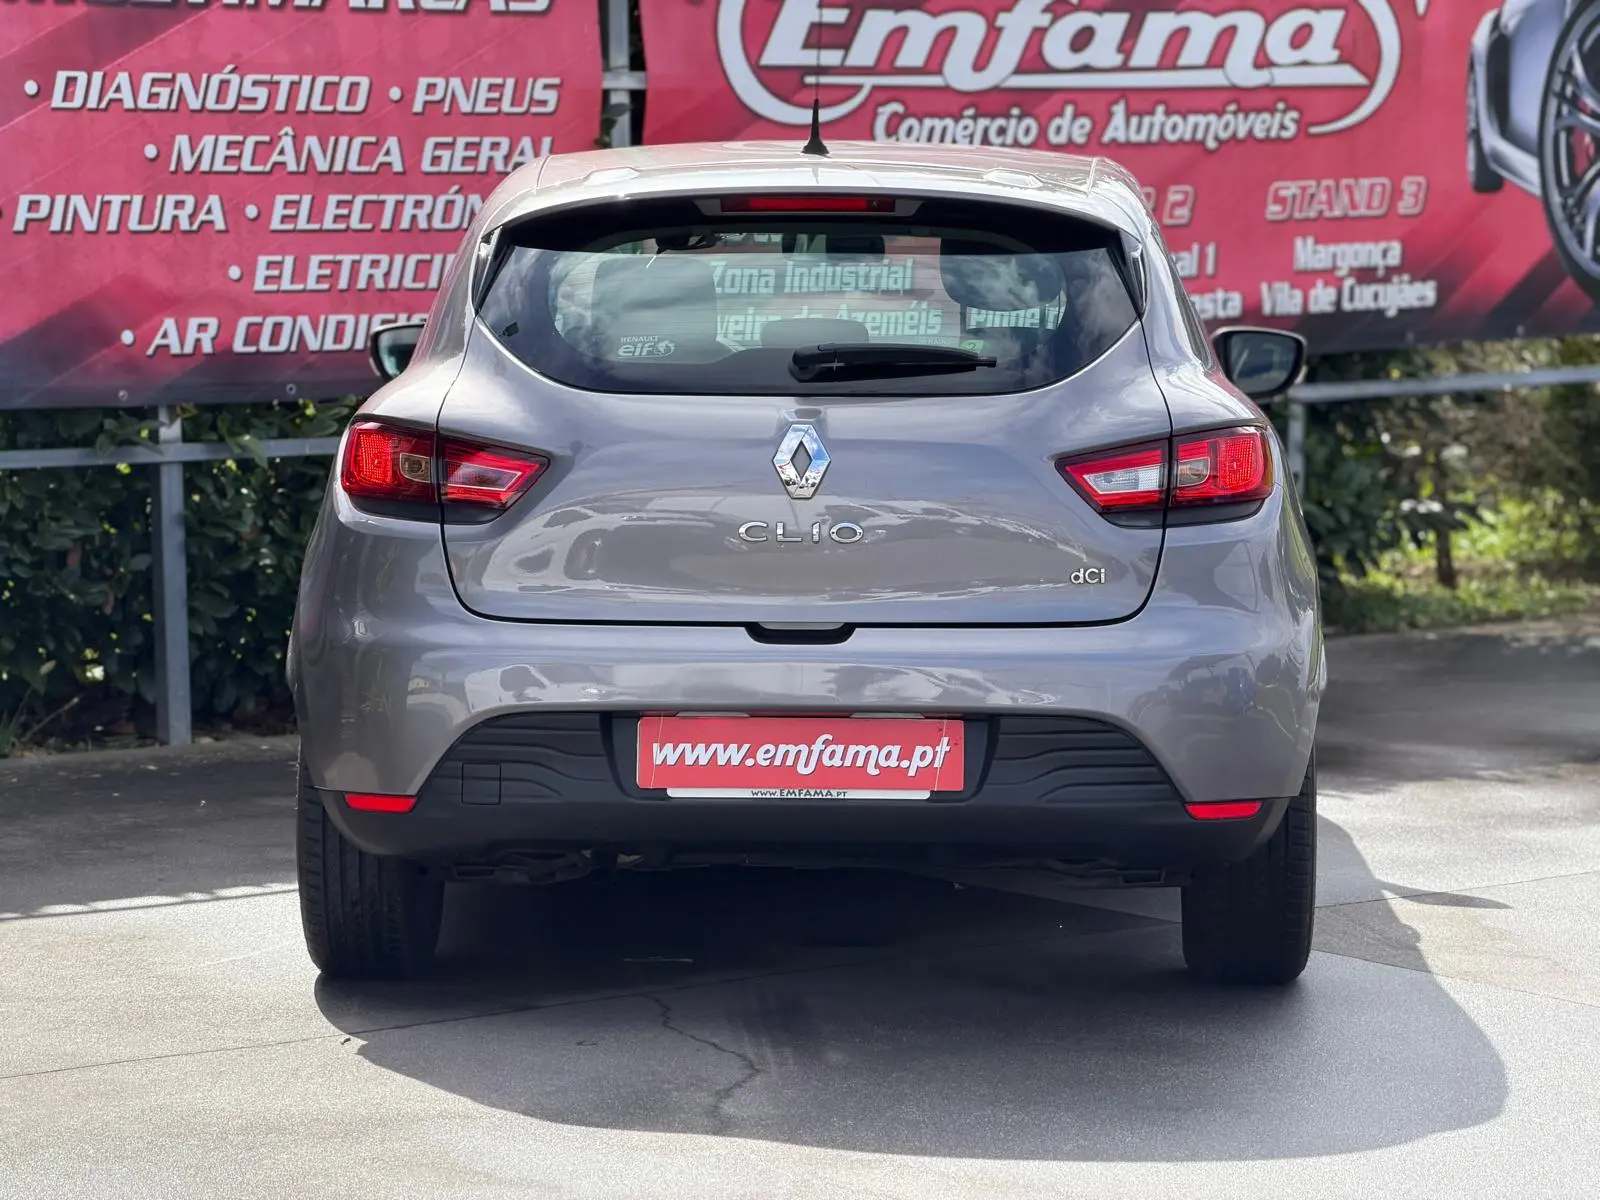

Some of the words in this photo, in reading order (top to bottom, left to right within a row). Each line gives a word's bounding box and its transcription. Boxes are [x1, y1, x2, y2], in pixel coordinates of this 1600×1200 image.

[50, 65, 371, 113] DIAGNÓSTICO
[411, 77, 562, 115] PNEUS
[874, 102, 1039, 147] Comércio
[1047, 104, 1093, 144] de
[1102, 99, 1300, 150] Automóveis
[169, 127, 405, 174] MECÂNICA
[12, 194, 228, 233] PINTURA
[269, 185, 484, 231] ELECTRÓN
[1265, 177, 1393, 221] STAND
[1397, 176, 1428, 216] 3
[253, 254, 455, 292] ELETRICI
[710, 260, 776, 294] Zona
[784, 258, 913, 294] Industrial
[1293, 236, 1403, 278] Margonça
[1260, 281, 1304, 316] Vila
[1308, 278, 1337, 314] de
[146, 317, 218, 356] AR
[231, 314, 428, 353] CONDI
[618, 342, 655, 356] elf
[738, 521, 864, 544] CLIO
[1070, 567, 1106, 584] dCi
[652, 733, 951, 777] www.emfama.pt
